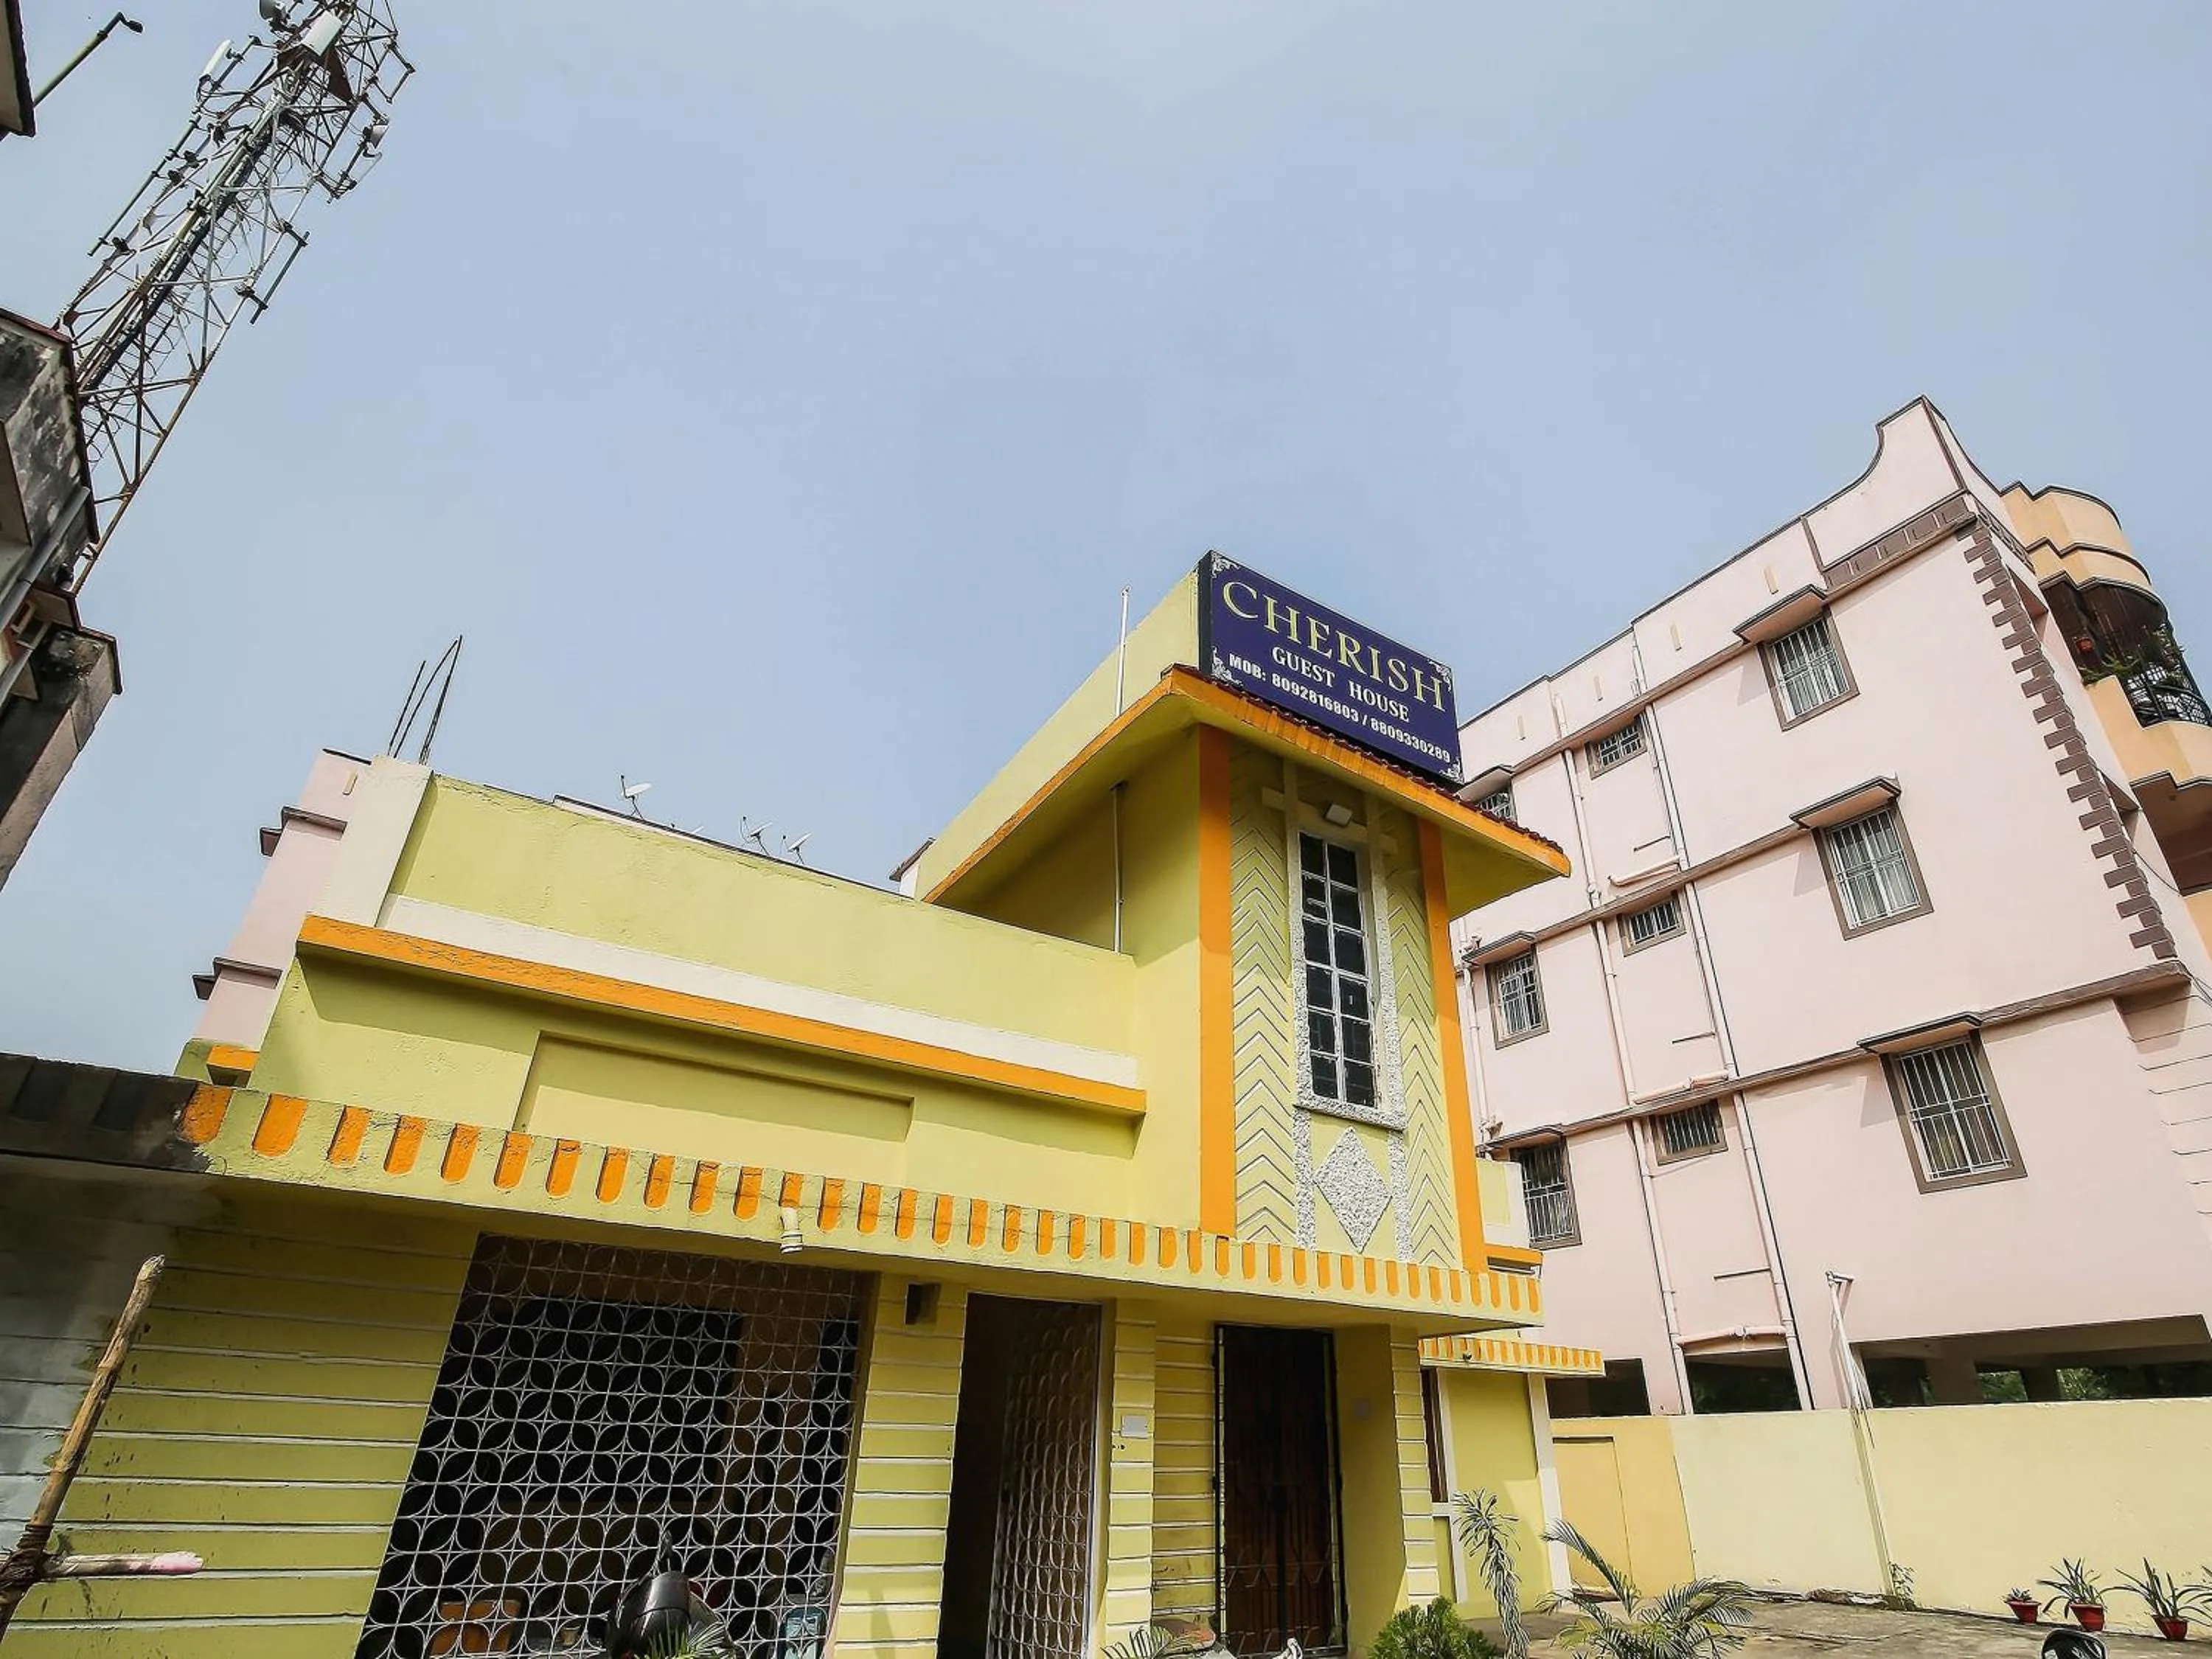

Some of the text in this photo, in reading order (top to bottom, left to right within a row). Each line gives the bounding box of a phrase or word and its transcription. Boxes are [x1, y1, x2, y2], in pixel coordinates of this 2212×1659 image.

[1222, 581, 1446, 712] CHERISH
[1229, 653, 1266, 681] MOB:
[1272, 647, 1410, 723] GUEST HOUSE
